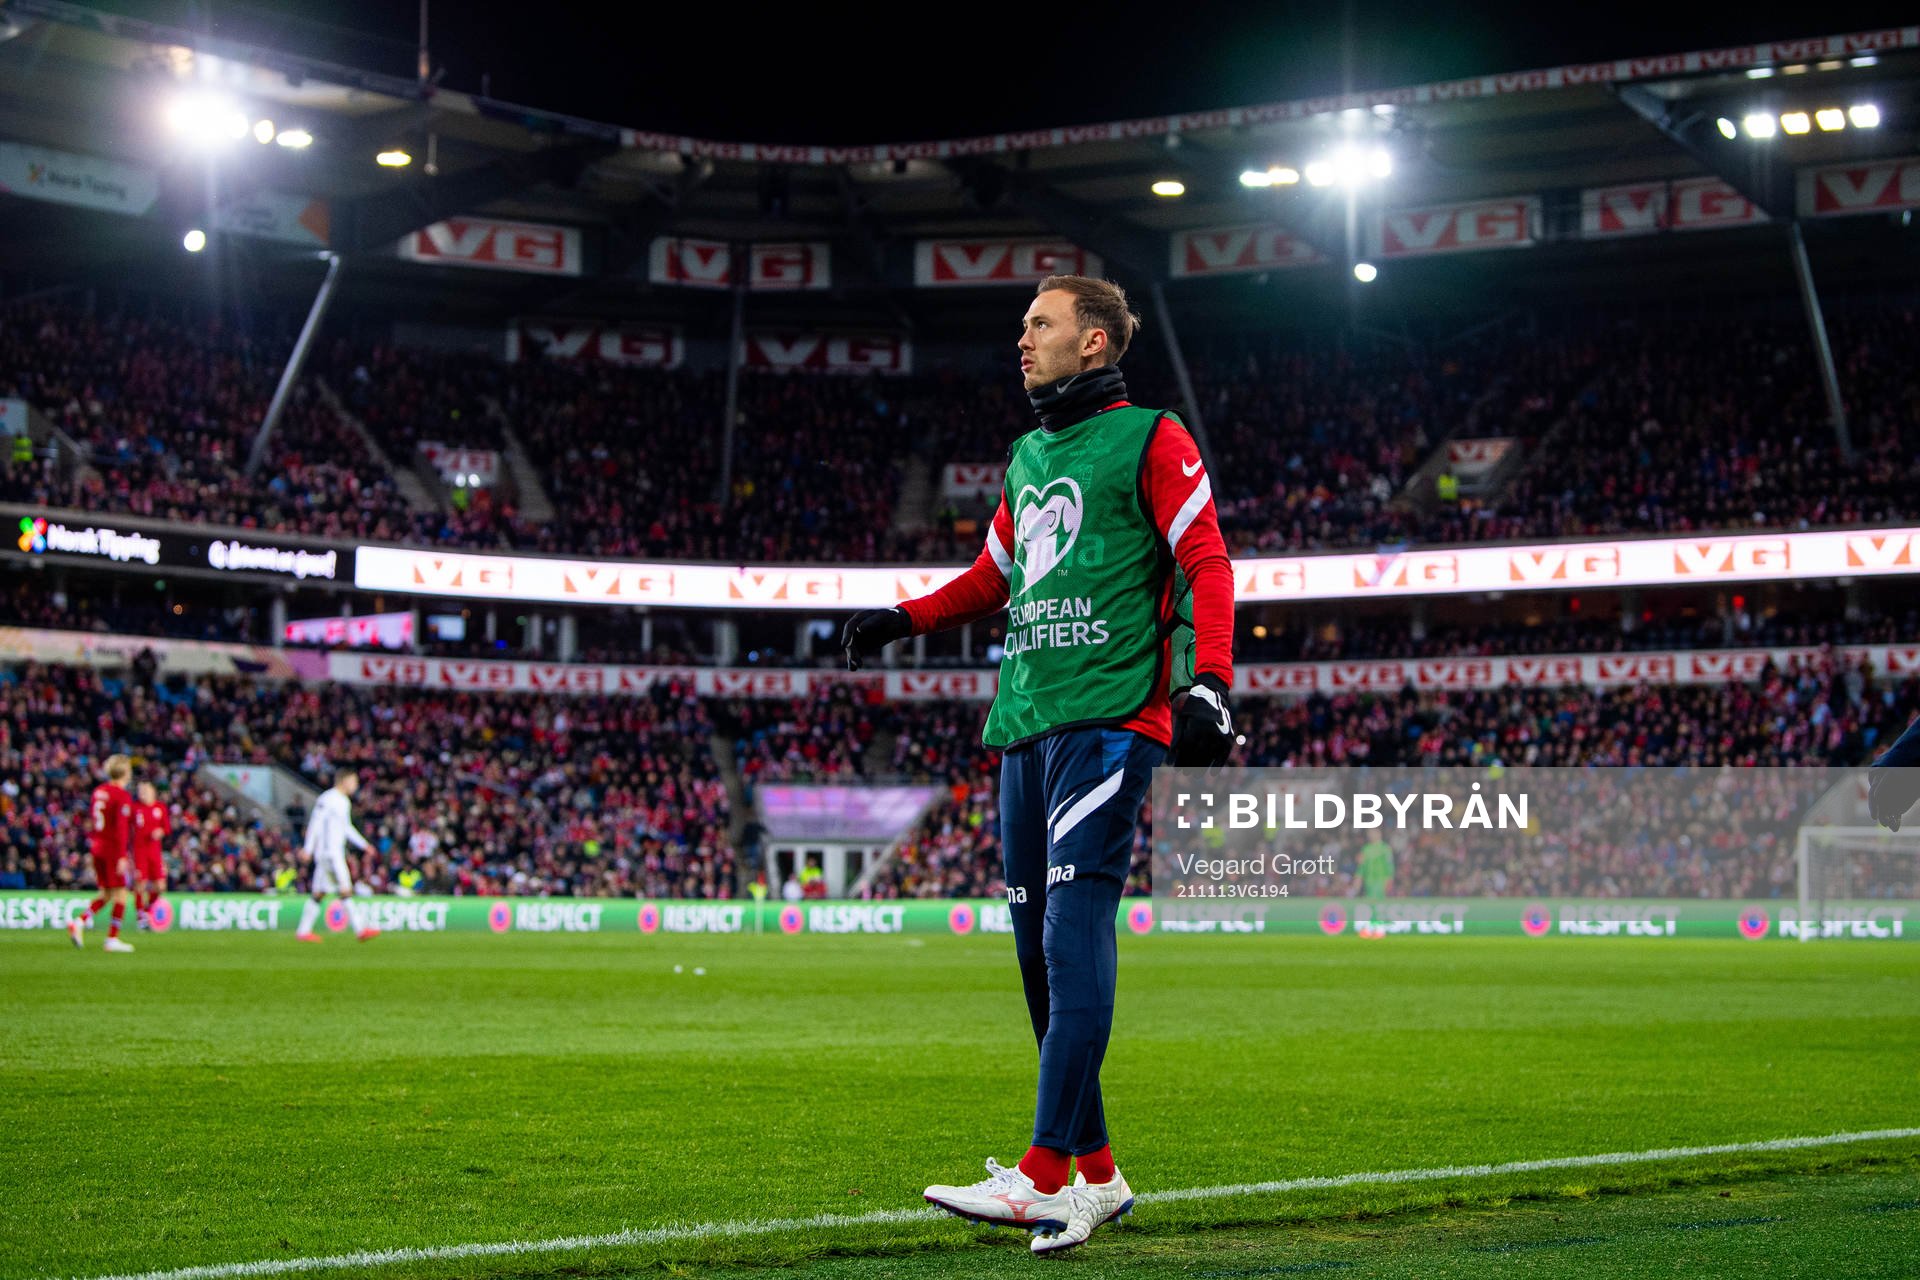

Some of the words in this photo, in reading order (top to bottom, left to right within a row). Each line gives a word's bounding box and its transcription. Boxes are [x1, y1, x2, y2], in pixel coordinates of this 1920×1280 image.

[1628, 54, 1685, 76] VG
[1699, 47, 1754, 68] VG
[1815, 162, 1920, 213] V
[417, 222, 564, 270] VG
[1382, 202, 1526, 256] VG
[666, 242, 812, 287] VG
[932, 241, 1086, 281] VG
[520, 326, 673, 363] VG
[746, 336, 900, 370] VG
[413, 558, 514, 591] VG
[564, 565, 675, 597] VG
[728, 572, 843, 601] VG
[1354, 553, 1459, 588] VG
[1509, 546, 1620, 581] VG
[1674, 538, 1791, 574] VG
[1847, 533, 1920, 568] V
[1057, 569, 1068, 577] TM
[1009, 597, 1092, 627] EUROPEAN
[180, 900, 281, 930] RESPECT
[516, 903, 602, 931] RESPECT
[663, 905, 744, 933] RESPECT
[809, 905, 904, 933] RESPECT
[1161, 903, 1269, 933] RESPECT
[1559, 905, 1681, 936] RESPECT
